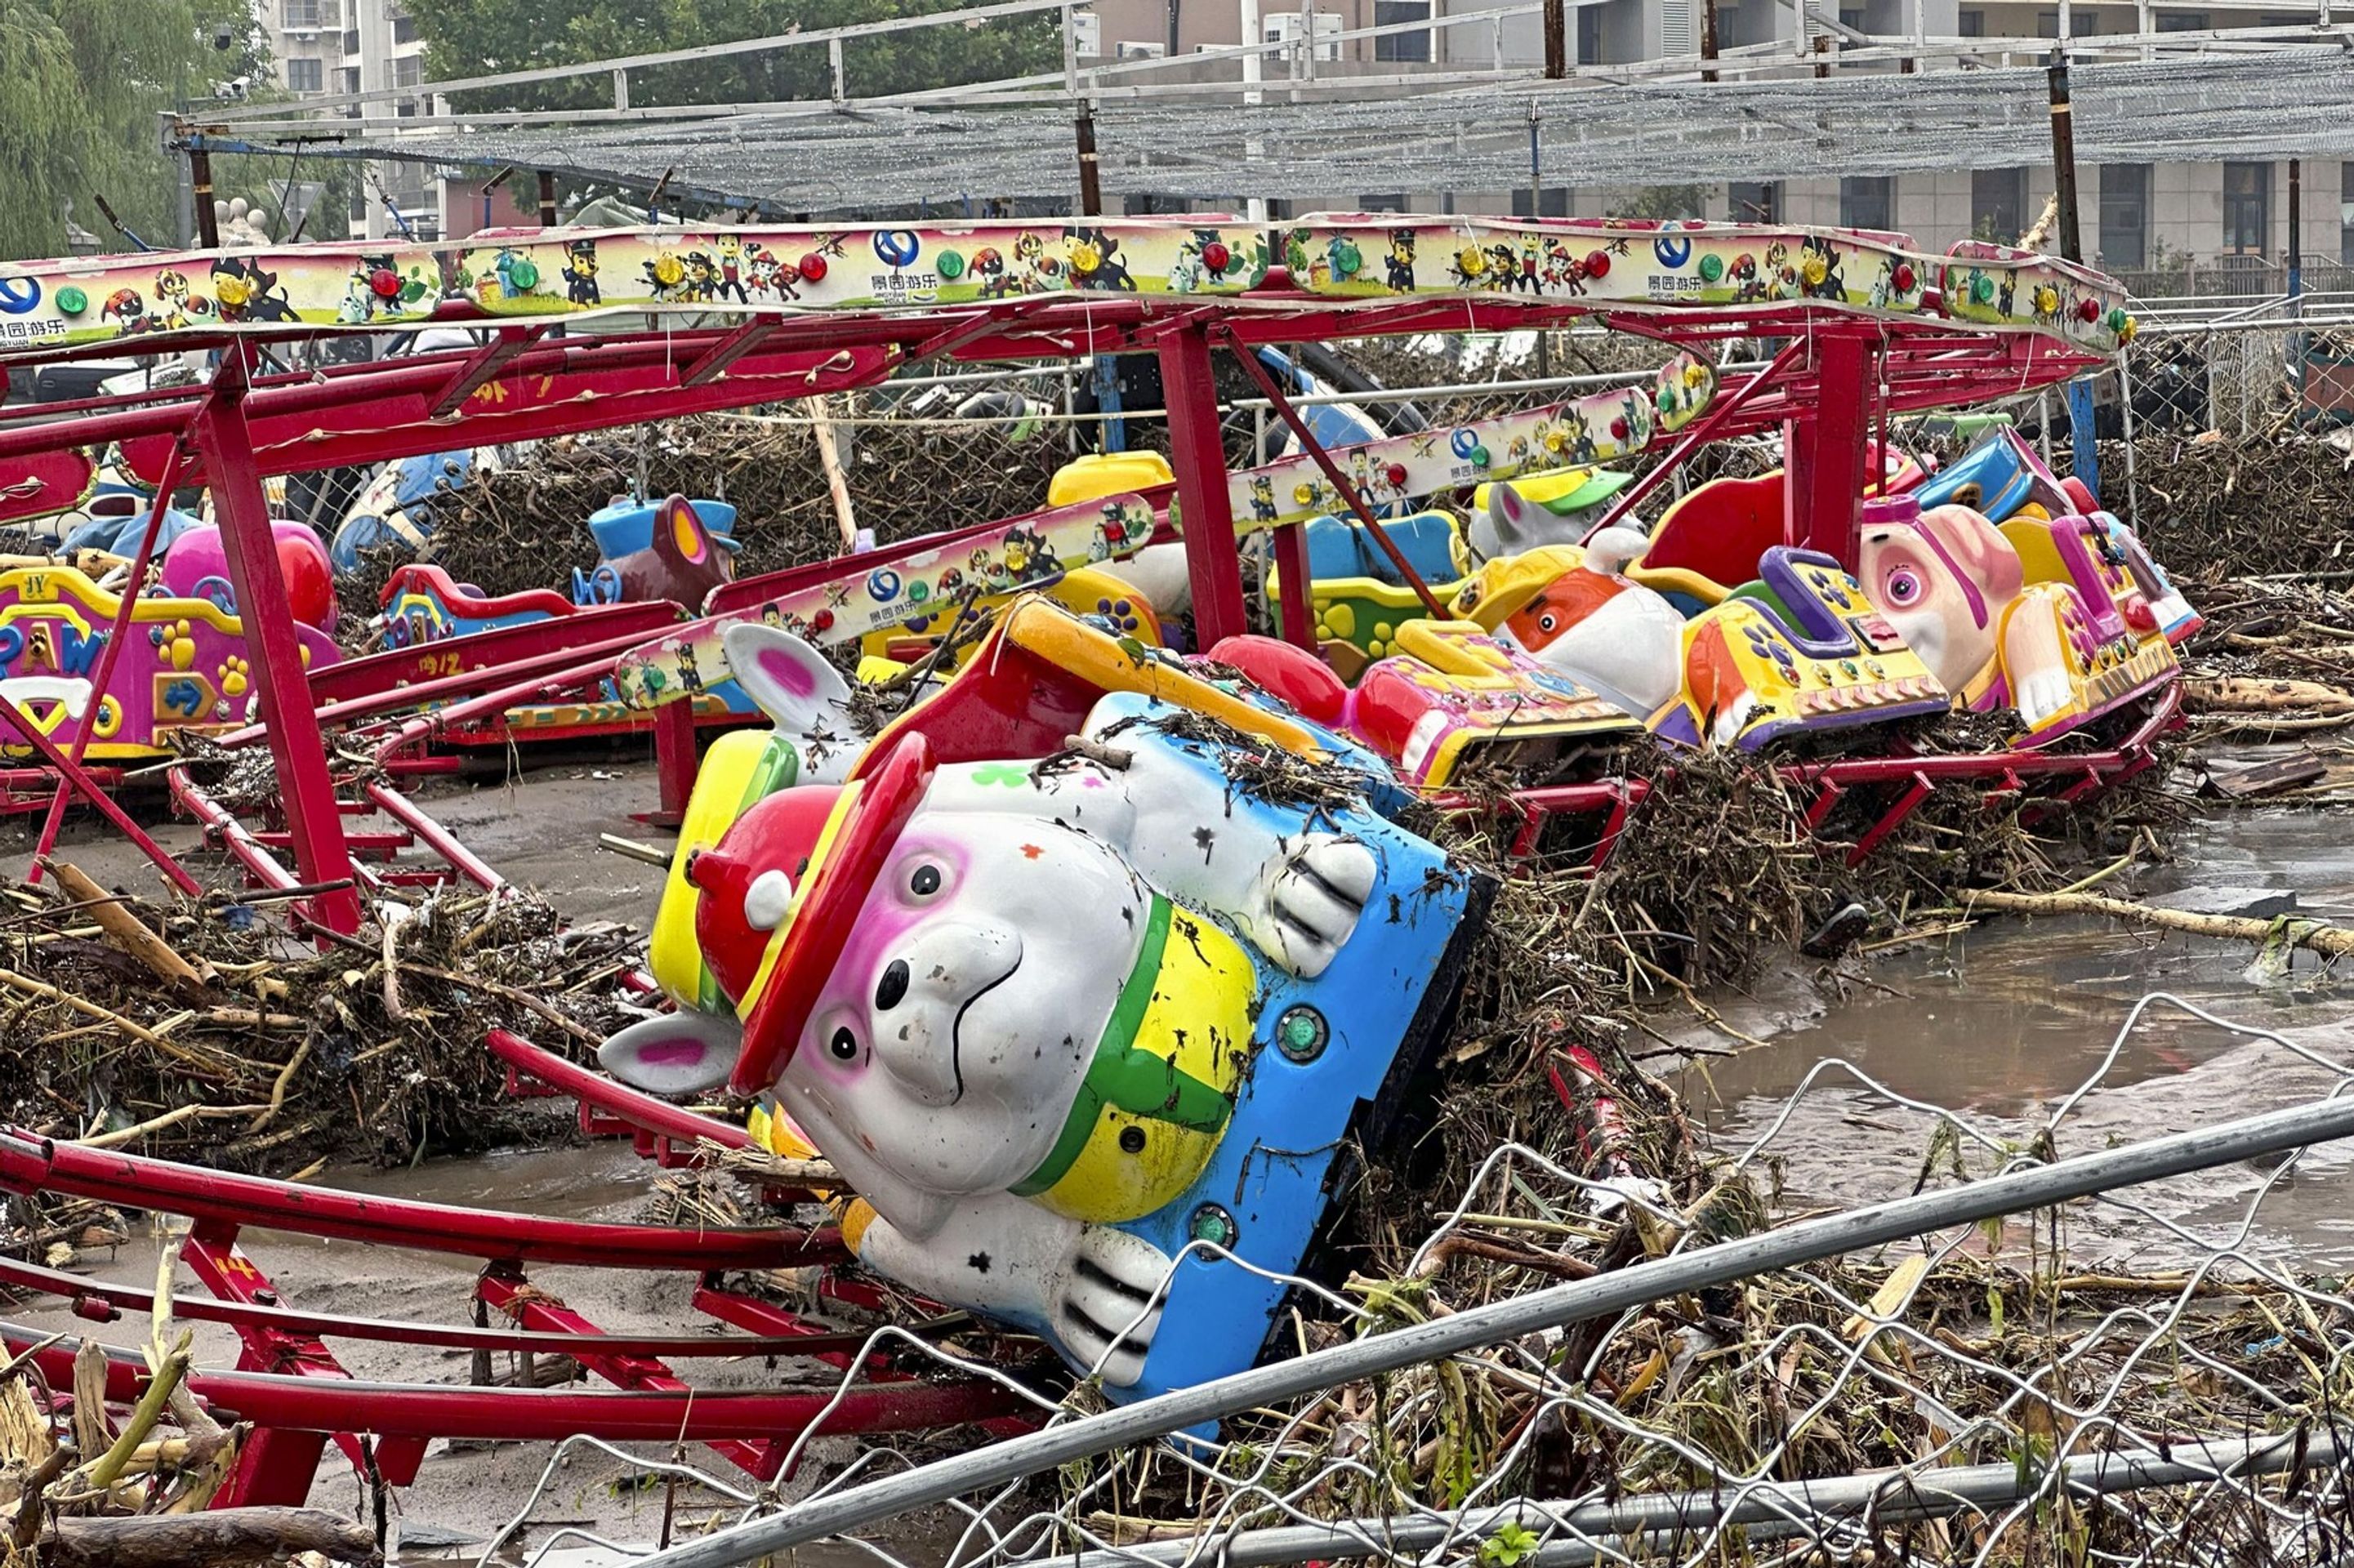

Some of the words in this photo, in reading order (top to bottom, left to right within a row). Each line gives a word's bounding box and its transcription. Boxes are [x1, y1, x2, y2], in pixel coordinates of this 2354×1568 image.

[871, 274, 938, 290] 景园游乐
[1648, 275, 1701, 291] 景园游乐
[25, 574, 45, 595] JY
[215, 1256, 256, 1281] 14
